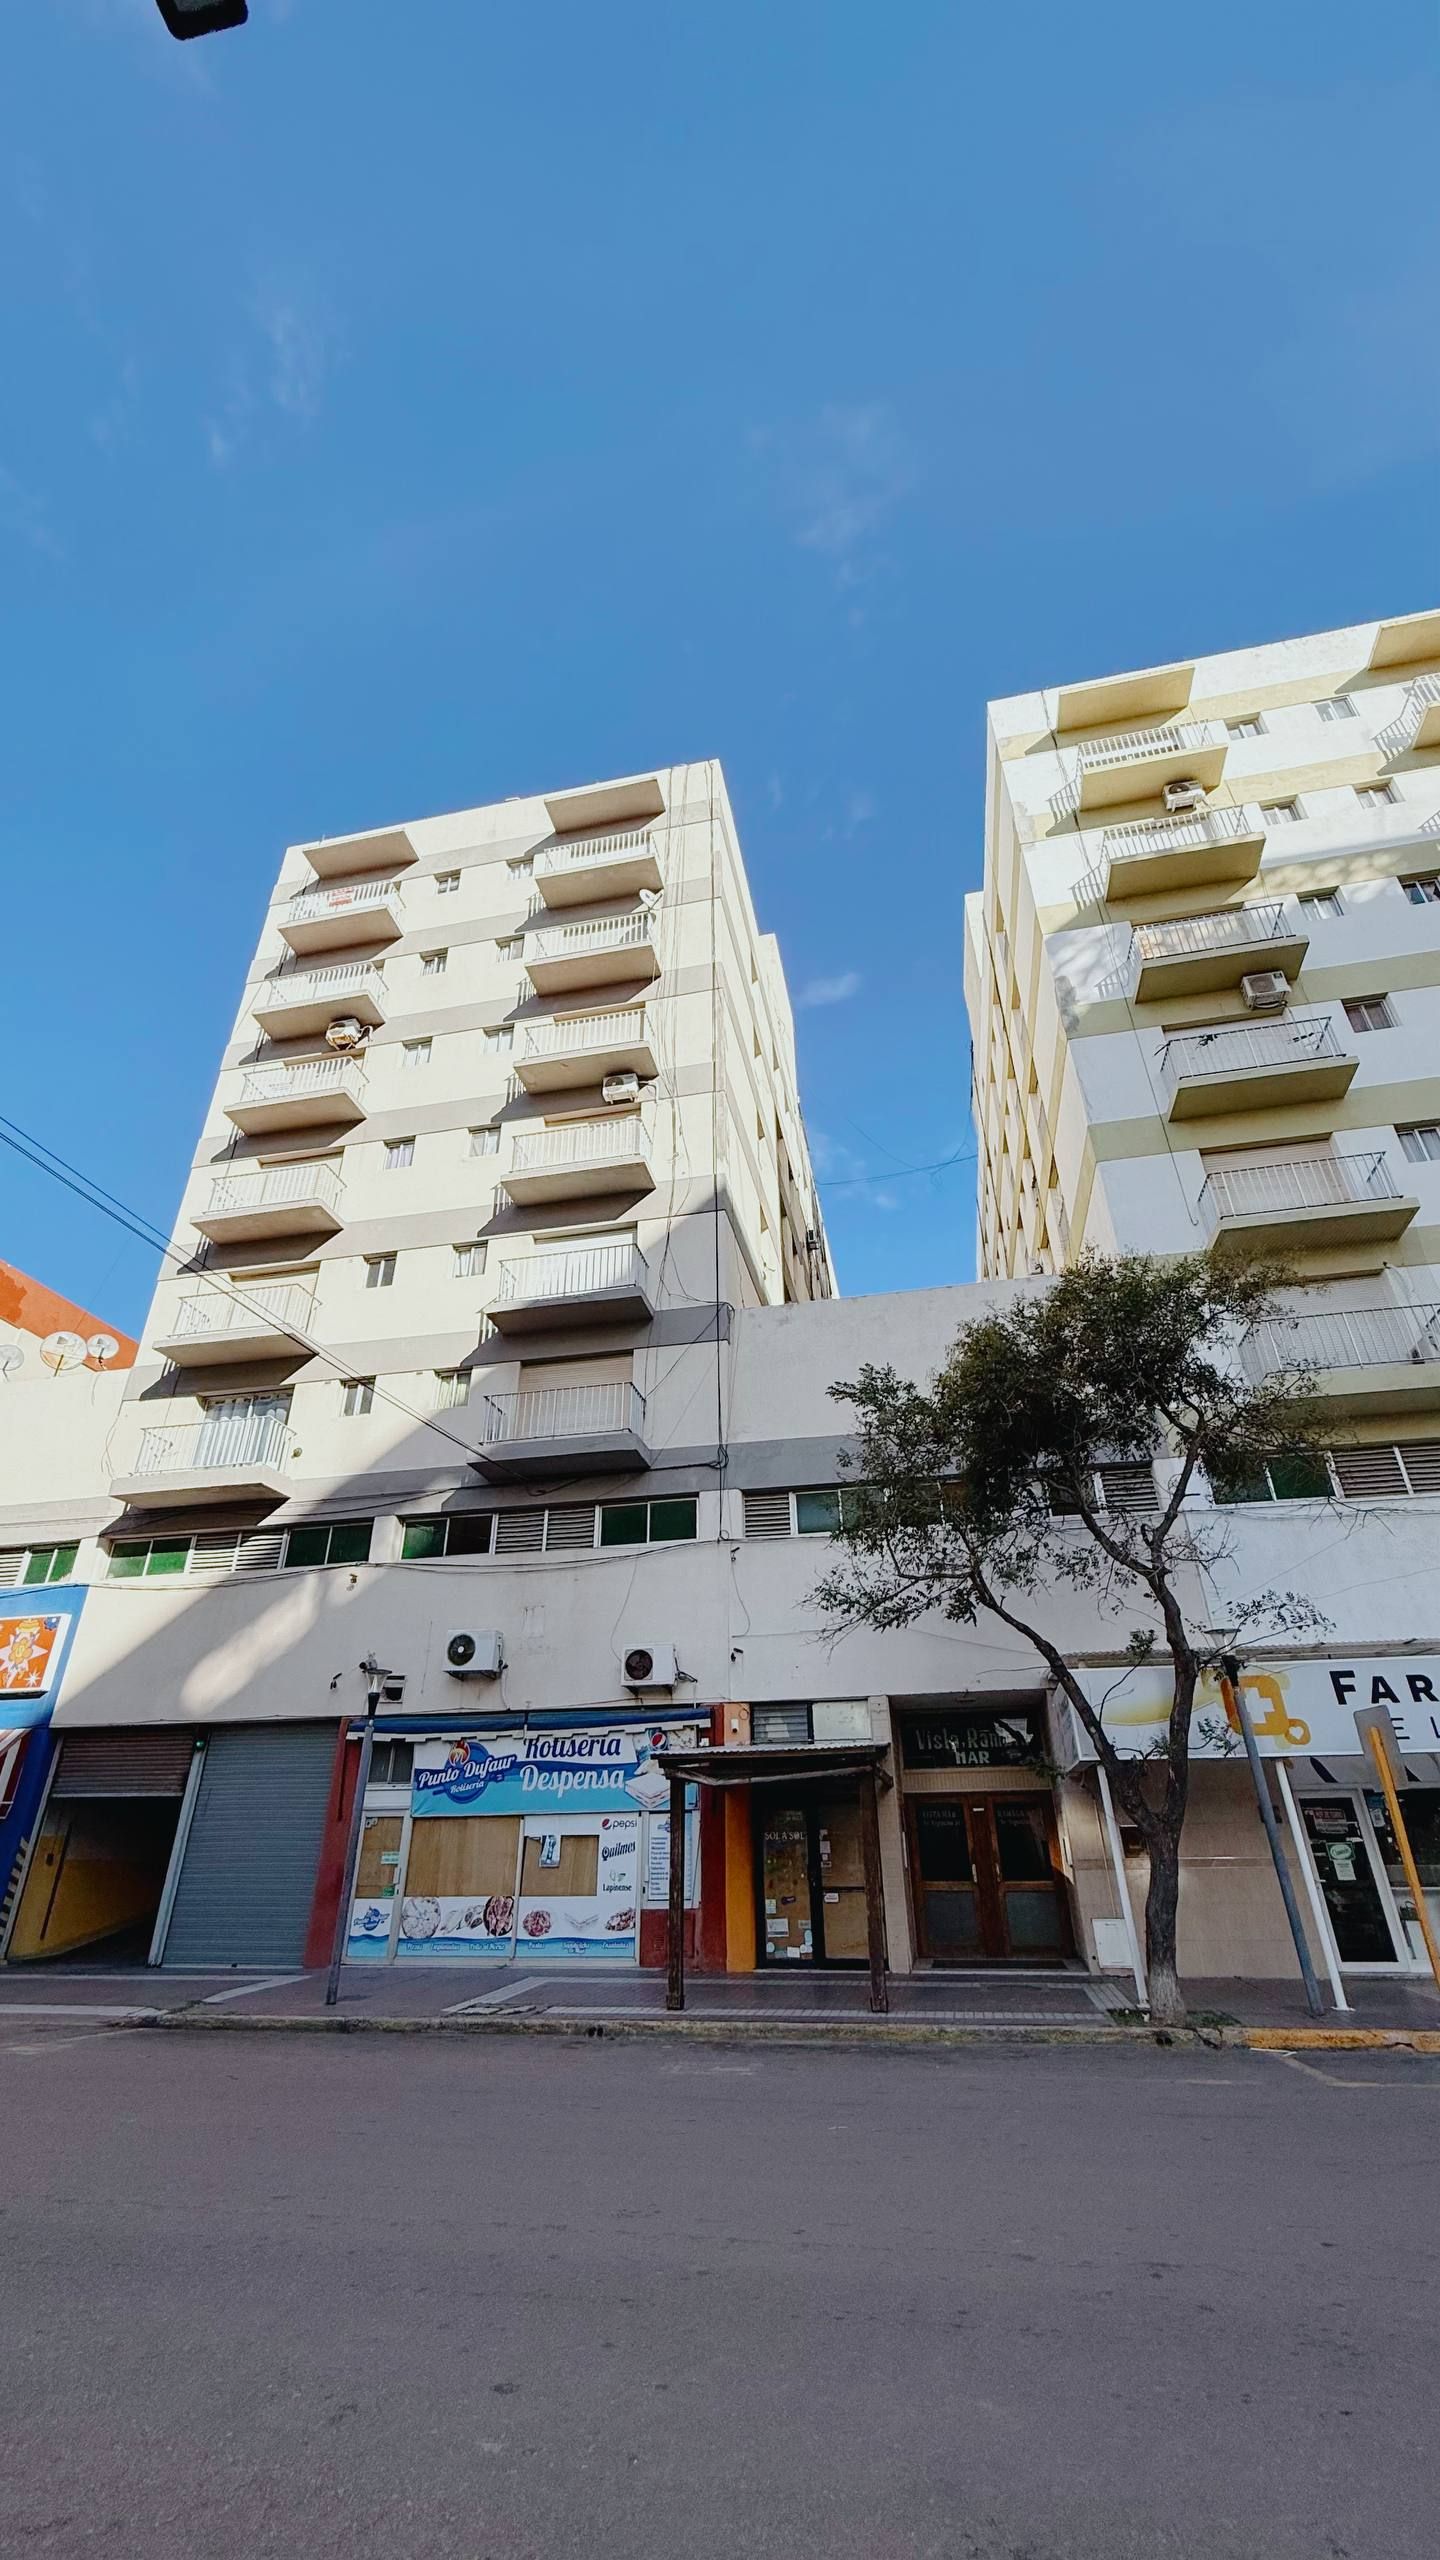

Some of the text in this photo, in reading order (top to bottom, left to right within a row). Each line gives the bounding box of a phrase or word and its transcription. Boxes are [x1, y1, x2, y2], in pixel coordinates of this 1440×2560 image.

[1329, 1670, 1439, 1705] FAR
[418, 1756, 515, 1788] Punto Dufaur
[519, 1764, 625, 1799] Despensa
[612, 1819, 638, 1830] pepsi
[764, 1831, 780, 1841] SOL
[602, 1841, 636, 1861] Quilmes
